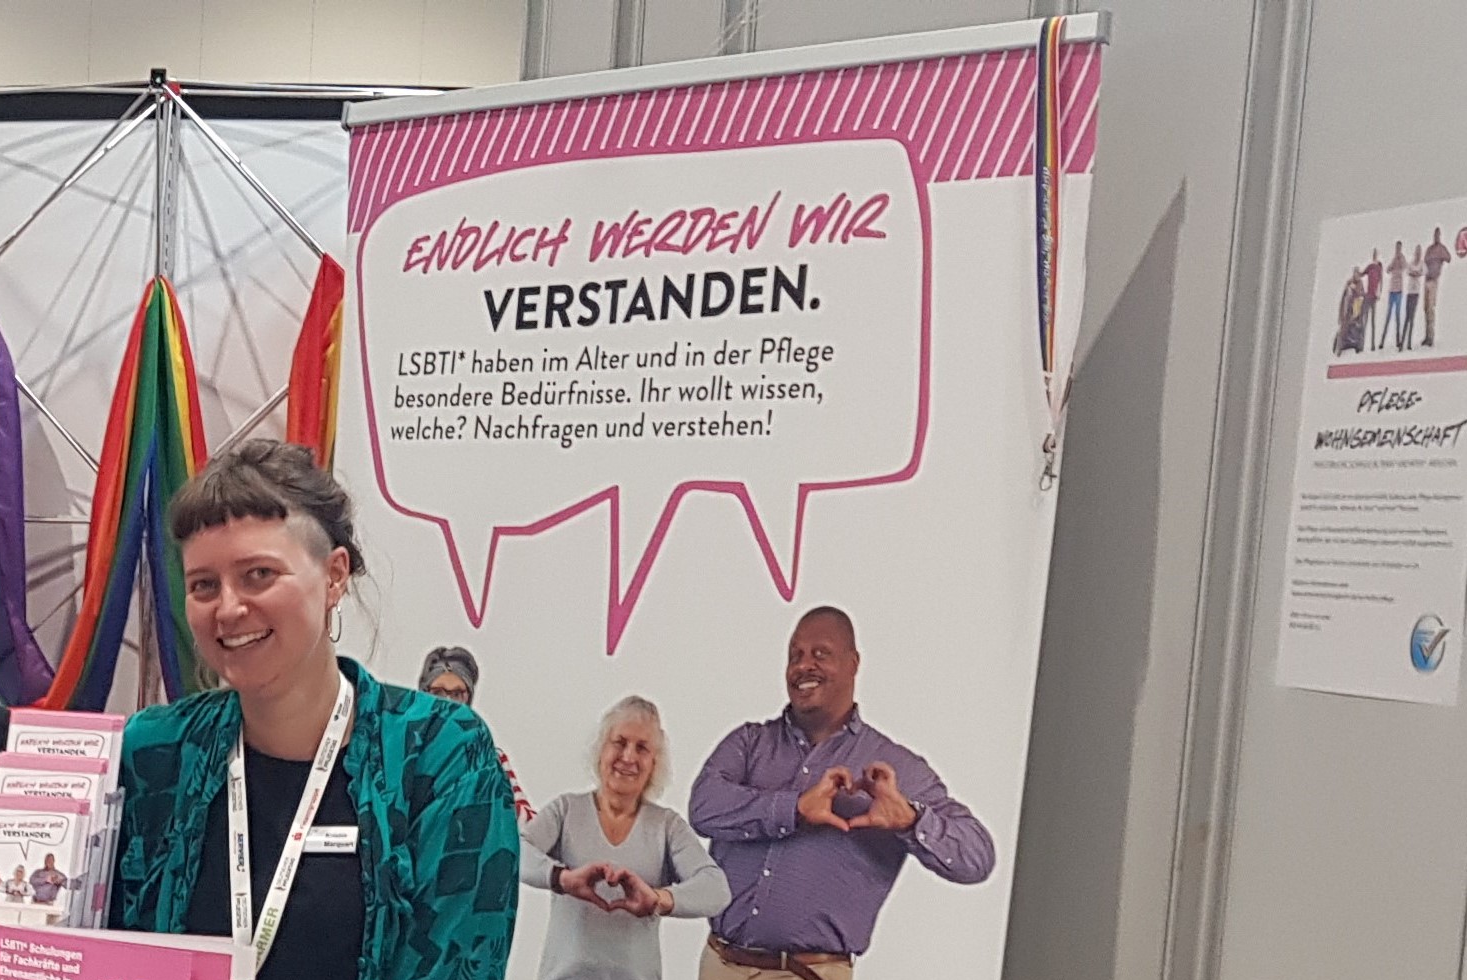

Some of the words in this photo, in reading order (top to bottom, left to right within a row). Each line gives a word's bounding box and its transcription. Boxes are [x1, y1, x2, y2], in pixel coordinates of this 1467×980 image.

[402, 217, 571, 273] ENDLICH
[589, 190, 781, 262] WERDEN
[788, 192, 890, 248] WIR
[483, 264, 821, 332] VERSTANDEN.
[471, 352, 534, 374] haben
[541, 354, 568, 372] im
[576, 347, 629, 371] Alter
[636, 342, 678, 368] und
[685, 345, 705, 366] in
[713, 341, 752, 365] der
[759, 337, 833, 372] Pflege
[394, 383, 493, 408] besondere
[502, 378, 630, 406] Bedürfnisse.
[640, 379, 670, 402] Ihr
[679, 375, 733, 401] wollt
[740, 377, 823, 404] wissen,
[390, 415, 465, 441] welche?
[473, 414, 598, 447] Nachfragen
[605, 414, 644, 438] und
[652, 409, 772, 436] verstehen!
